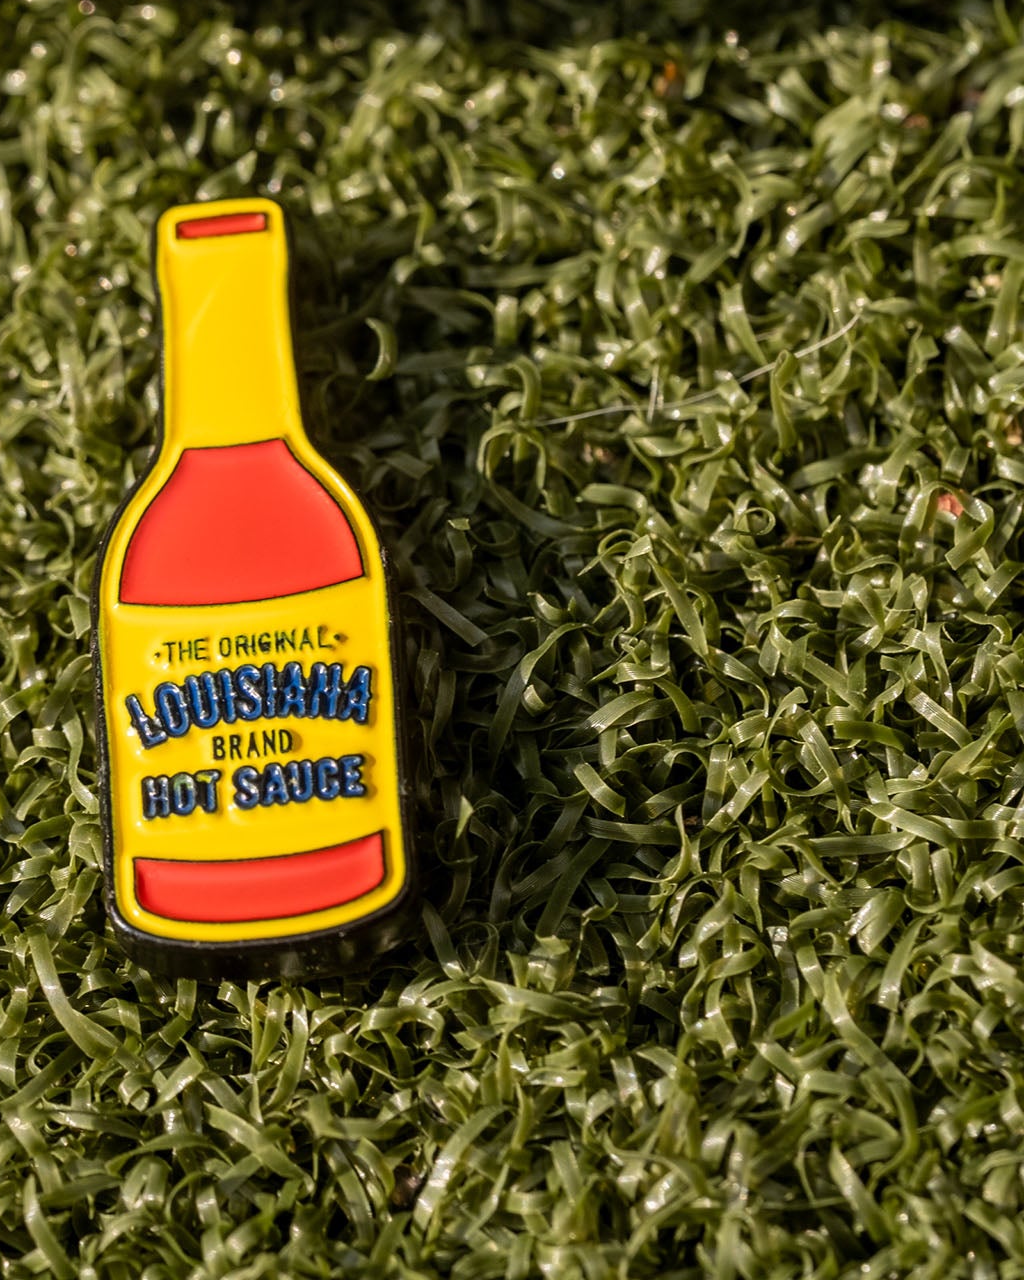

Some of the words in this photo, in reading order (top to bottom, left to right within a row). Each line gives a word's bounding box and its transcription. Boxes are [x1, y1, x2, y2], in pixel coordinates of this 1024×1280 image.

[126, 662, 372, 749] LOUISIANA
[212, 729, 294, 761] BRAND
[141, 769, 222, 820] HOT
[233, 754, 367, 810] SAUCE
